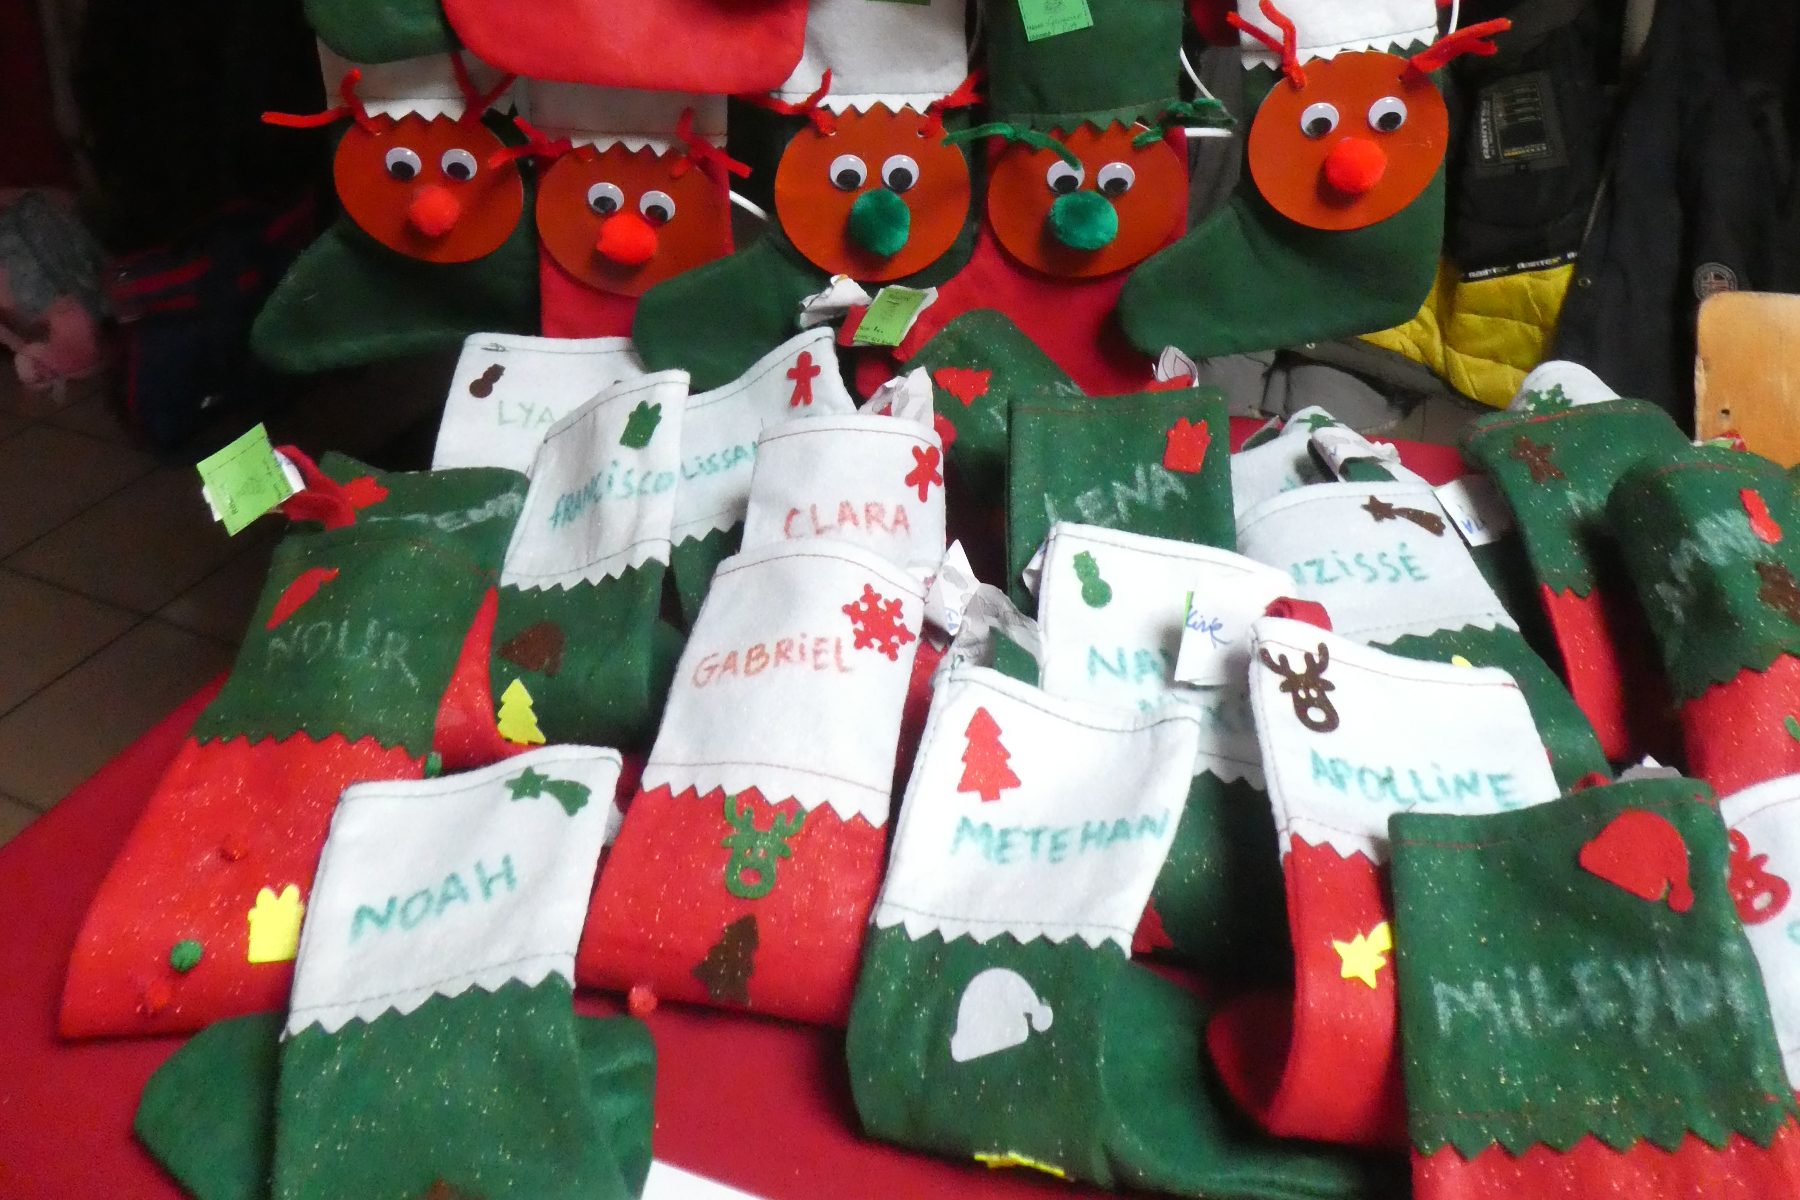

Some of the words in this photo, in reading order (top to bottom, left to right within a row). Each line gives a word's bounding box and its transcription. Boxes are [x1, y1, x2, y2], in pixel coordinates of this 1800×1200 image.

[784, 501, 910, 539] CLARA
[950, 808, 1170, 864] METEHAN
[348, 853, 517, 946] NOAH
